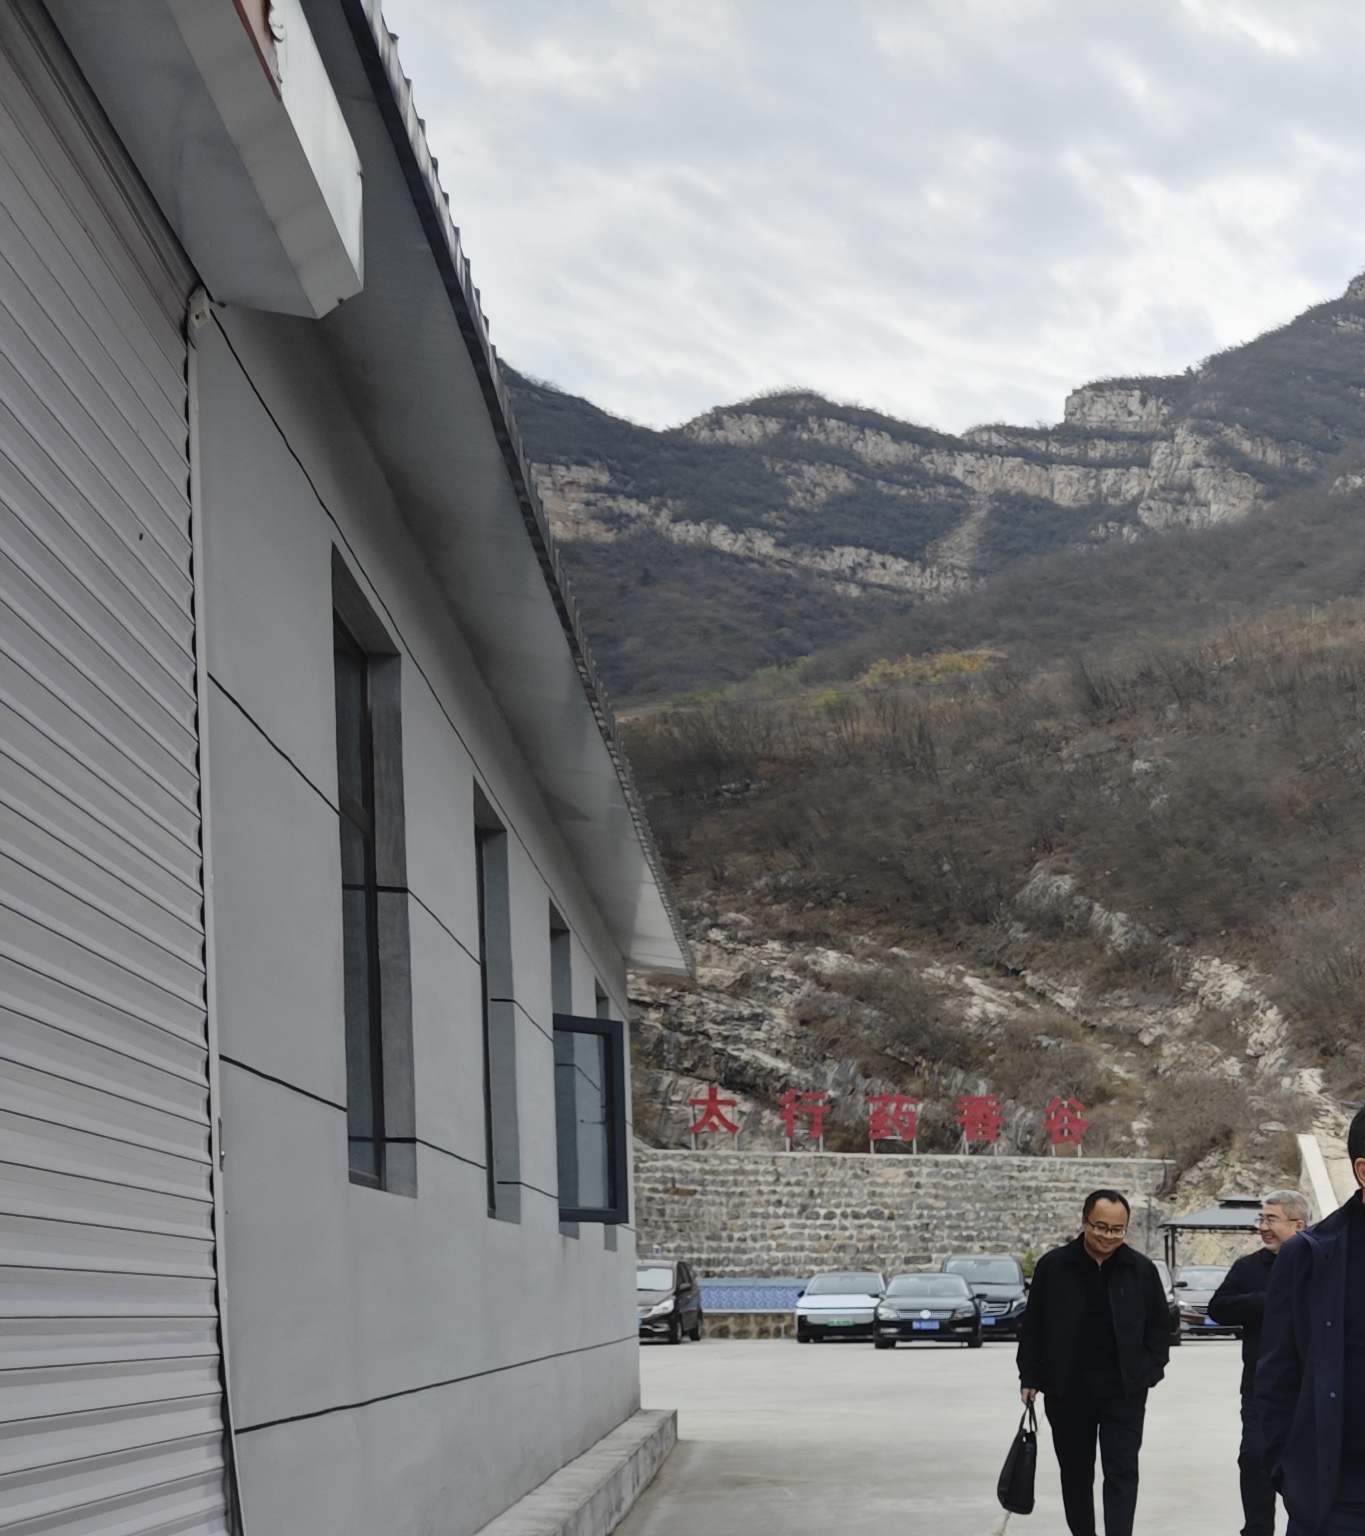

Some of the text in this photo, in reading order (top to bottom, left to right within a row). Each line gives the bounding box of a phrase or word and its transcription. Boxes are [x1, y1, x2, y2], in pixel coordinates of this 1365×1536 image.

[689, 1086, 1089, 1144] 太行药香谷
